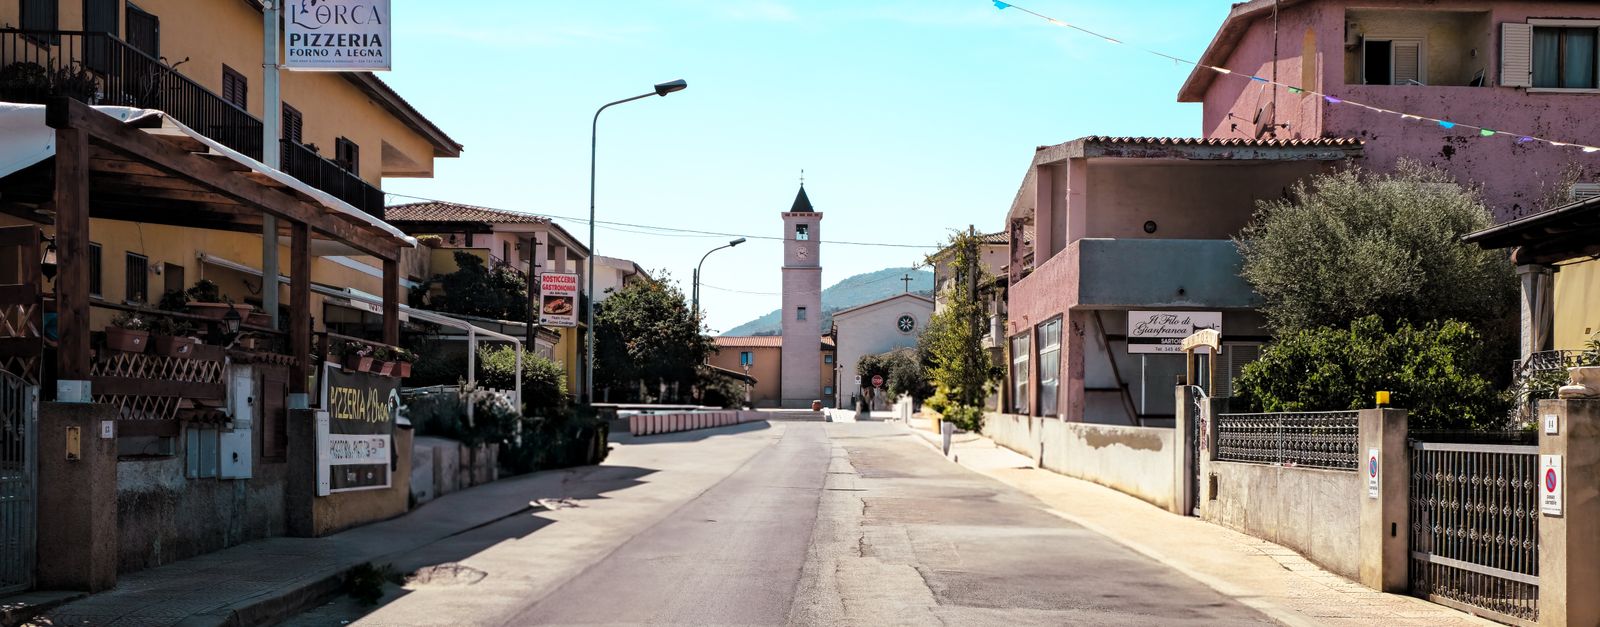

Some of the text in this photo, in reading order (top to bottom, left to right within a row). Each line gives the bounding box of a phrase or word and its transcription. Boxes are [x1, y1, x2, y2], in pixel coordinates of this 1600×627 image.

[289, 33, 383, 47] PIZZERIA
[289, 48, 383, 57] FORNO A LEGNA
[1146, 314, 1191, 325] Il Filo di
[1133, 321, 1187, 336] Gianfranca
[330, 386, 366, 420] PIZZERIA
